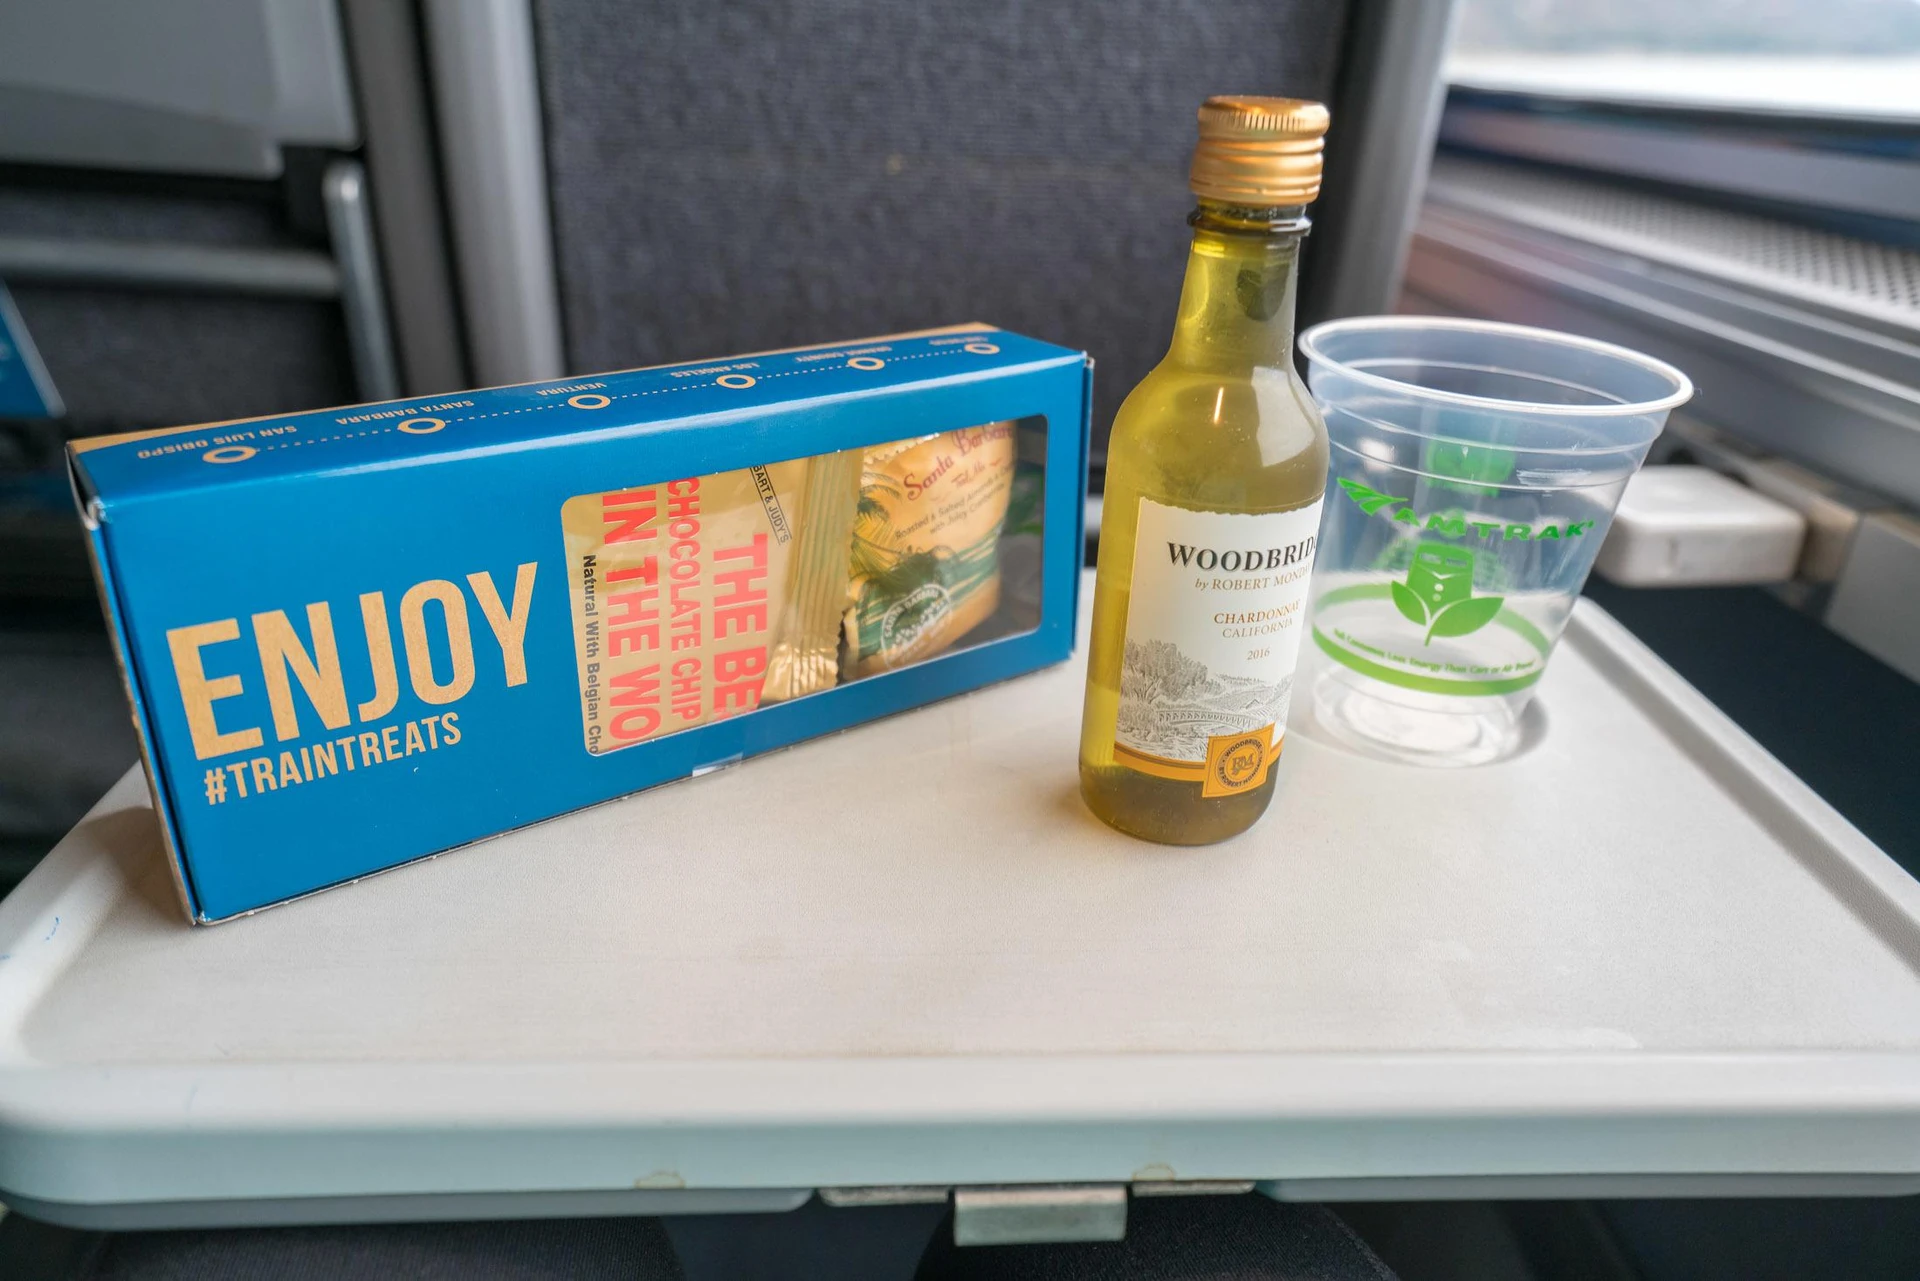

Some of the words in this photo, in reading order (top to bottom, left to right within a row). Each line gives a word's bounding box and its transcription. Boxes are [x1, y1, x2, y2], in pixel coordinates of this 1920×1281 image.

[670, 364, 732, 378] ANGELES
[733, 361, 760, 371] LOS
[420, 400, 475, 413] SANTA
[537, 382, 607, 396] VENTURA
[259, 425, 298, 437] SAN
[335, 409, 418, 425] BARBARA
[137, 439, 209, 459] OBISPO
[213, 431, 256, 445] LUIS
[753, 464, 771, 493] BART
[903, 456, 955, 501] Santa
[764, 495, 774, 504] &
[602, 490, 658, 545] IN
[768, 506, 790, 543] JUDY'S
[1392, 507, 1594, 541] AMTRAK
[667, 476, 702, 653] CHOCOLATE
[1167, 535, 1316, 572] WOODBRID
[583, 555, 599, 617] Natural
[713, 533, 769, 641] THE
[1194, 577, 1210, 591] by
[1211, 576, 1271, 591] ROBERT
[605, 555, 660, 658] THE
[585, 620, 600, 658] With
[1221, 617, 1293, 639] CALIFORNIA
[166, 561, 538, 760] ENJOY
[1246, 646, 1271, 661] 2016
[585, 662, 601, 721] Belgian
[671, 657, 702, 722] CHIP
[713, 646, 768, 720] BE
[609, 663, 662, 748] WO
[588, 725, 602, 755] Cho
[204, 711, 463, 806] #TRAINTREATS
